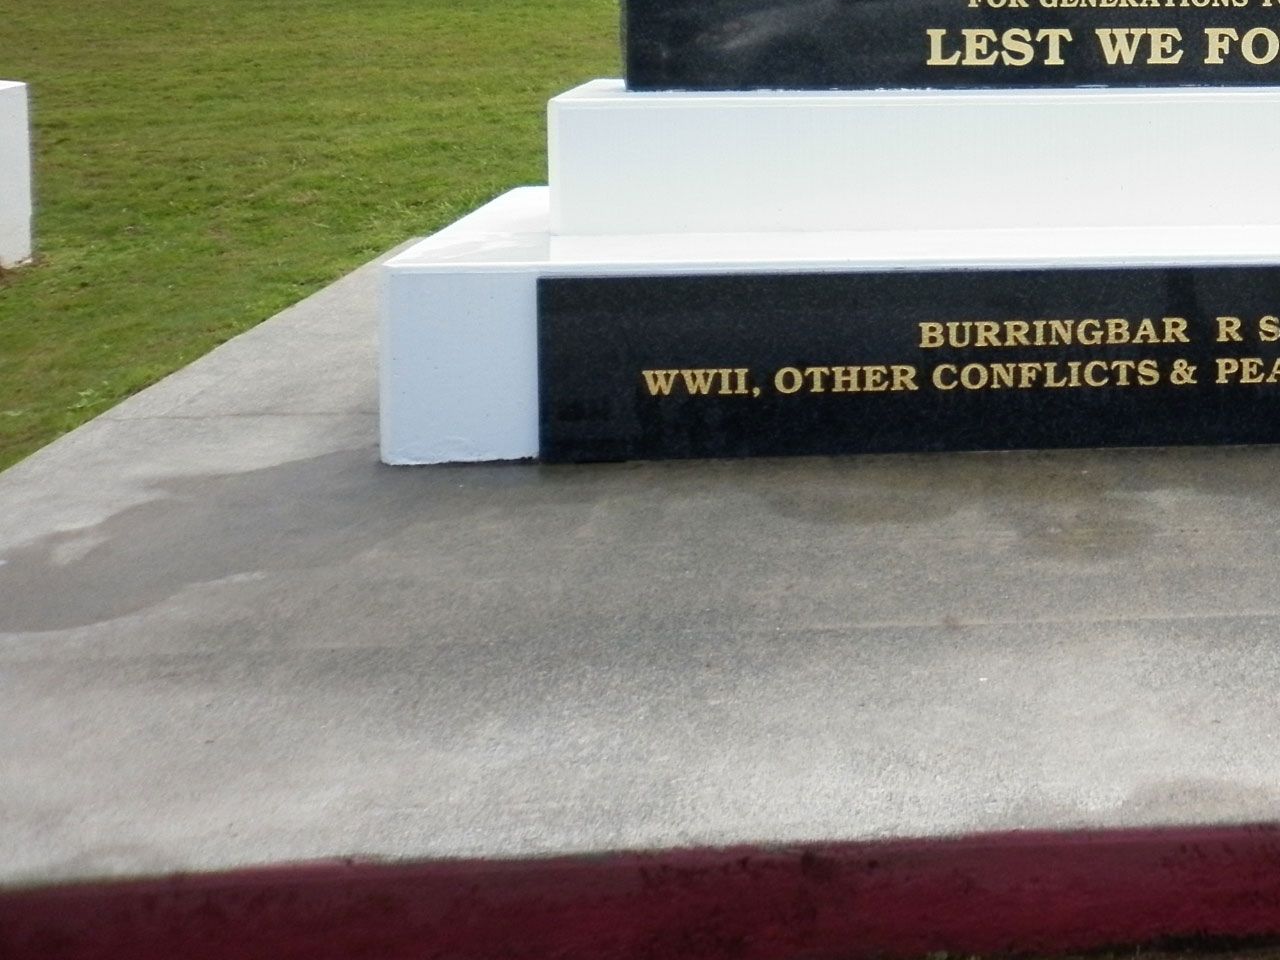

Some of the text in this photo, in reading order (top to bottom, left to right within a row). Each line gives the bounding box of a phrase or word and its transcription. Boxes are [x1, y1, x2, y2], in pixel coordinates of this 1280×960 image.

[926, 27, 1073, 67] LEST
[1094, 27, 1185, 65] WE
[918, 317, 1191, 348] BURRINGBAR
[1215, 316, 1244, 343] R
[641, 367, 761, 398] WWII,
[774, 364, 919, 394] OTHER
[932, 359, 1160, 391] CONFLICTS
[1169, 358, 1198, 386] &
